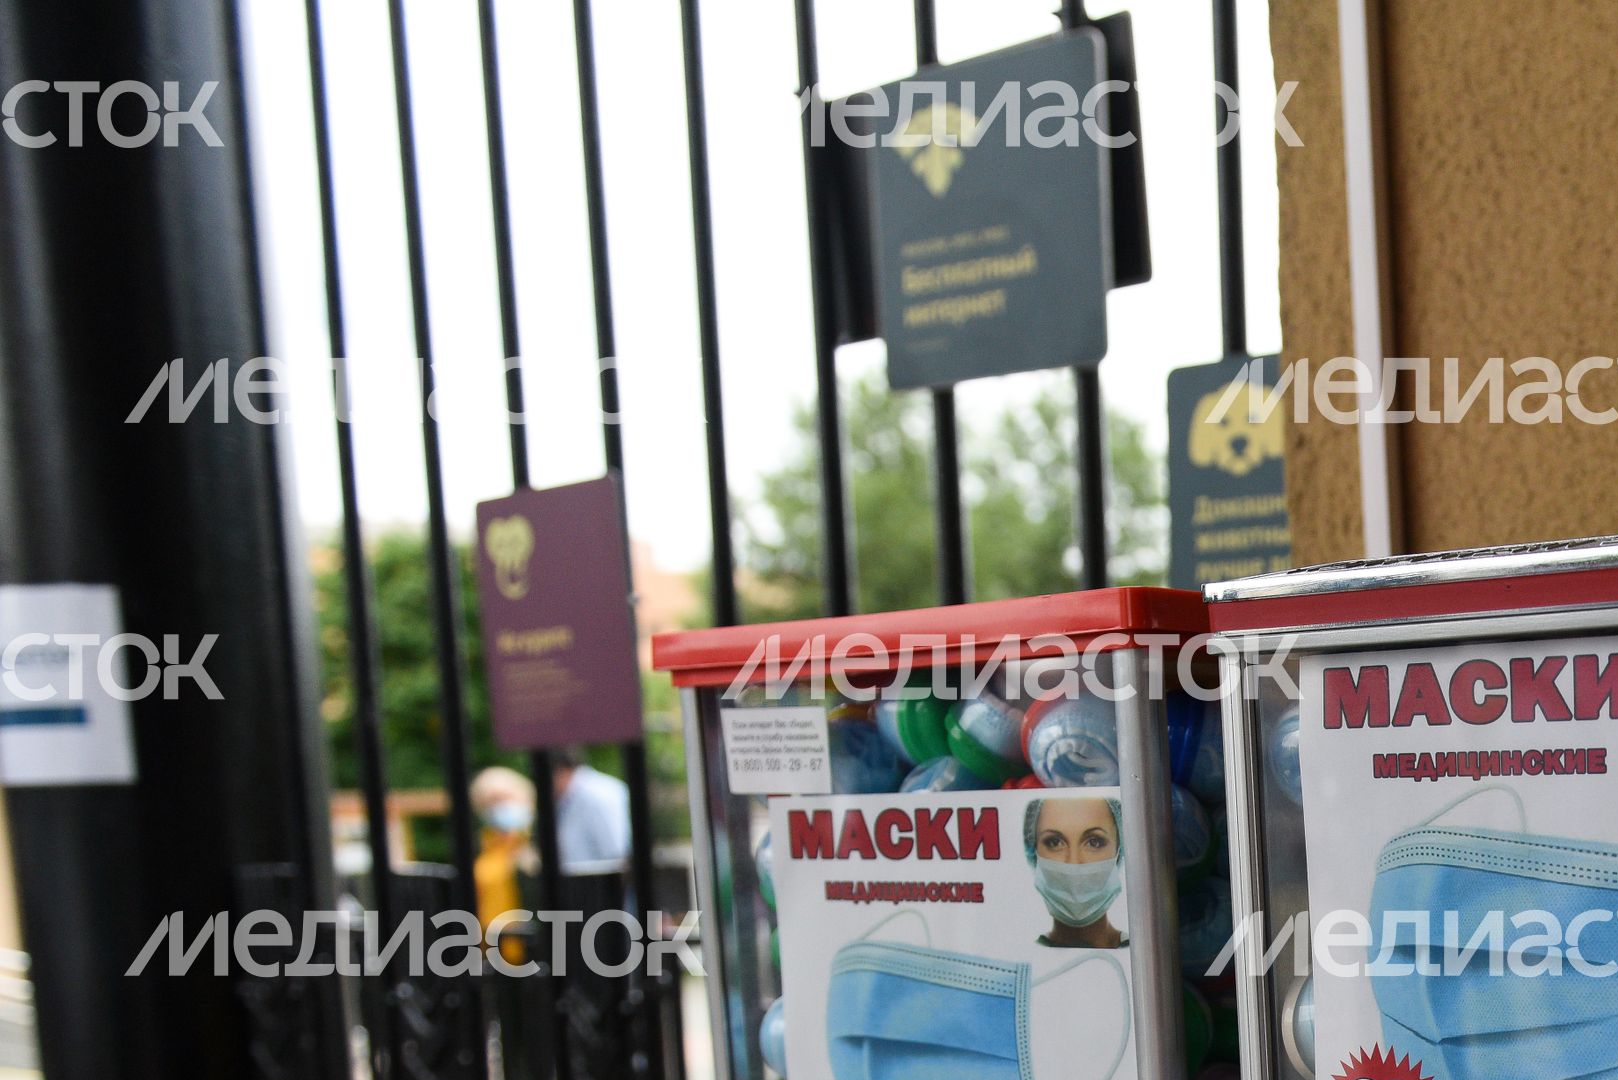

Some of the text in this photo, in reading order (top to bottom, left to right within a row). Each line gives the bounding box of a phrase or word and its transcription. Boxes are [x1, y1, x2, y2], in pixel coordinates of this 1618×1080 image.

[1372, 747, 1607, 783] МЕДИЦИНСКИЕ
[788, 807, 1000, 860] МАСКИ
[825, 880, 984, 904] МЕДИЦИНСКИЕ
